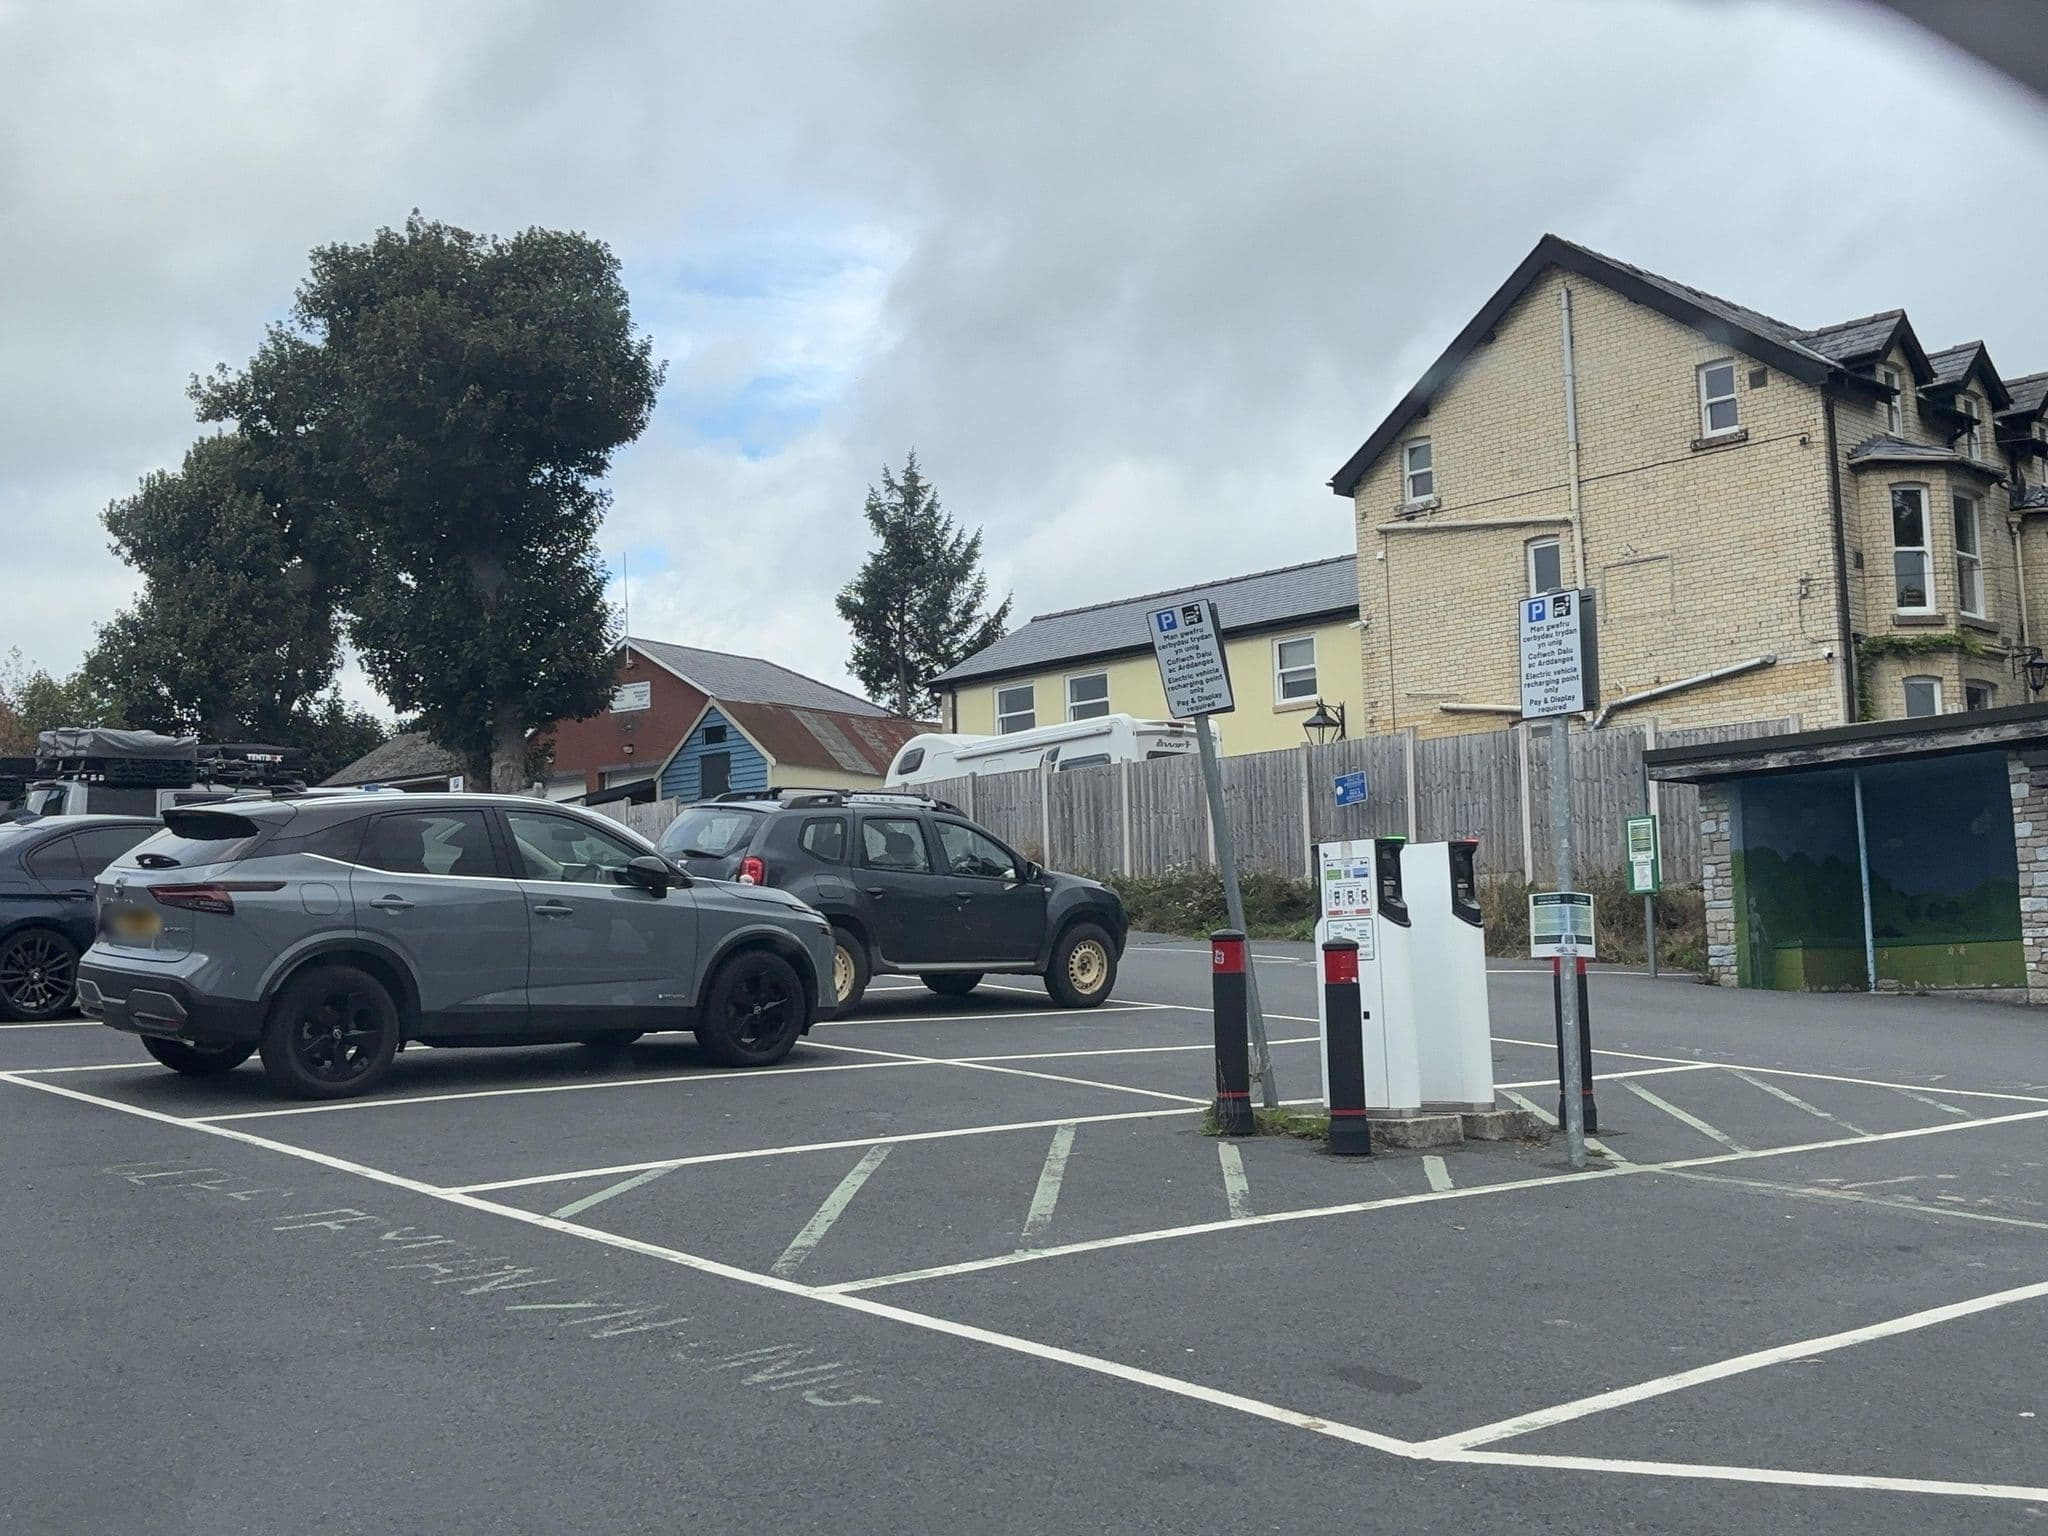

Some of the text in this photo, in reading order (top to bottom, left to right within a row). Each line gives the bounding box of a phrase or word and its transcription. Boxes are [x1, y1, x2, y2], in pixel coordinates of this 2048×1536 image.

[1531, 604, 1543, 620] P
[1160, 613, 1174, 630] P
[1546, 621, 1570, 631] gwefru
[1163, 632, 1179, 642] Man
[1190, 633, 1213, 643] trydan
[1523, 627, 1577, 643] cerbydau trydan
[1547, 638, 1563, 647] unig
[1174, 644, 1200, 655] yn unig
[1196, 650, 1213, 659] Dalu
[1527, 647, 1574, 660] Cofiwch Dalu
[1178, 658, 1214, 671] Arddangos
[1537, 655, 1574, 667] Arddangos
[1167, 667, 1220, 684] Electric vehicle
[1525, 667, 1577, 680] Electric vehicle
[1167, 674, 1224, 692] recharging point
[1524, 674, 1579, 688] recharging point
[1189, 686, 1205, 694] only
[1544, 686, 1559, 694] only
[1176, 698, 1189, 707] Pay
[1197, 692, 1223, 702] Display
[1529, 698, 1542, 706] Pay
[1550, 694, 1575, 704] Display
[1186, 701, 1216, 712] required
[1538, 703, 1567, 713] required
